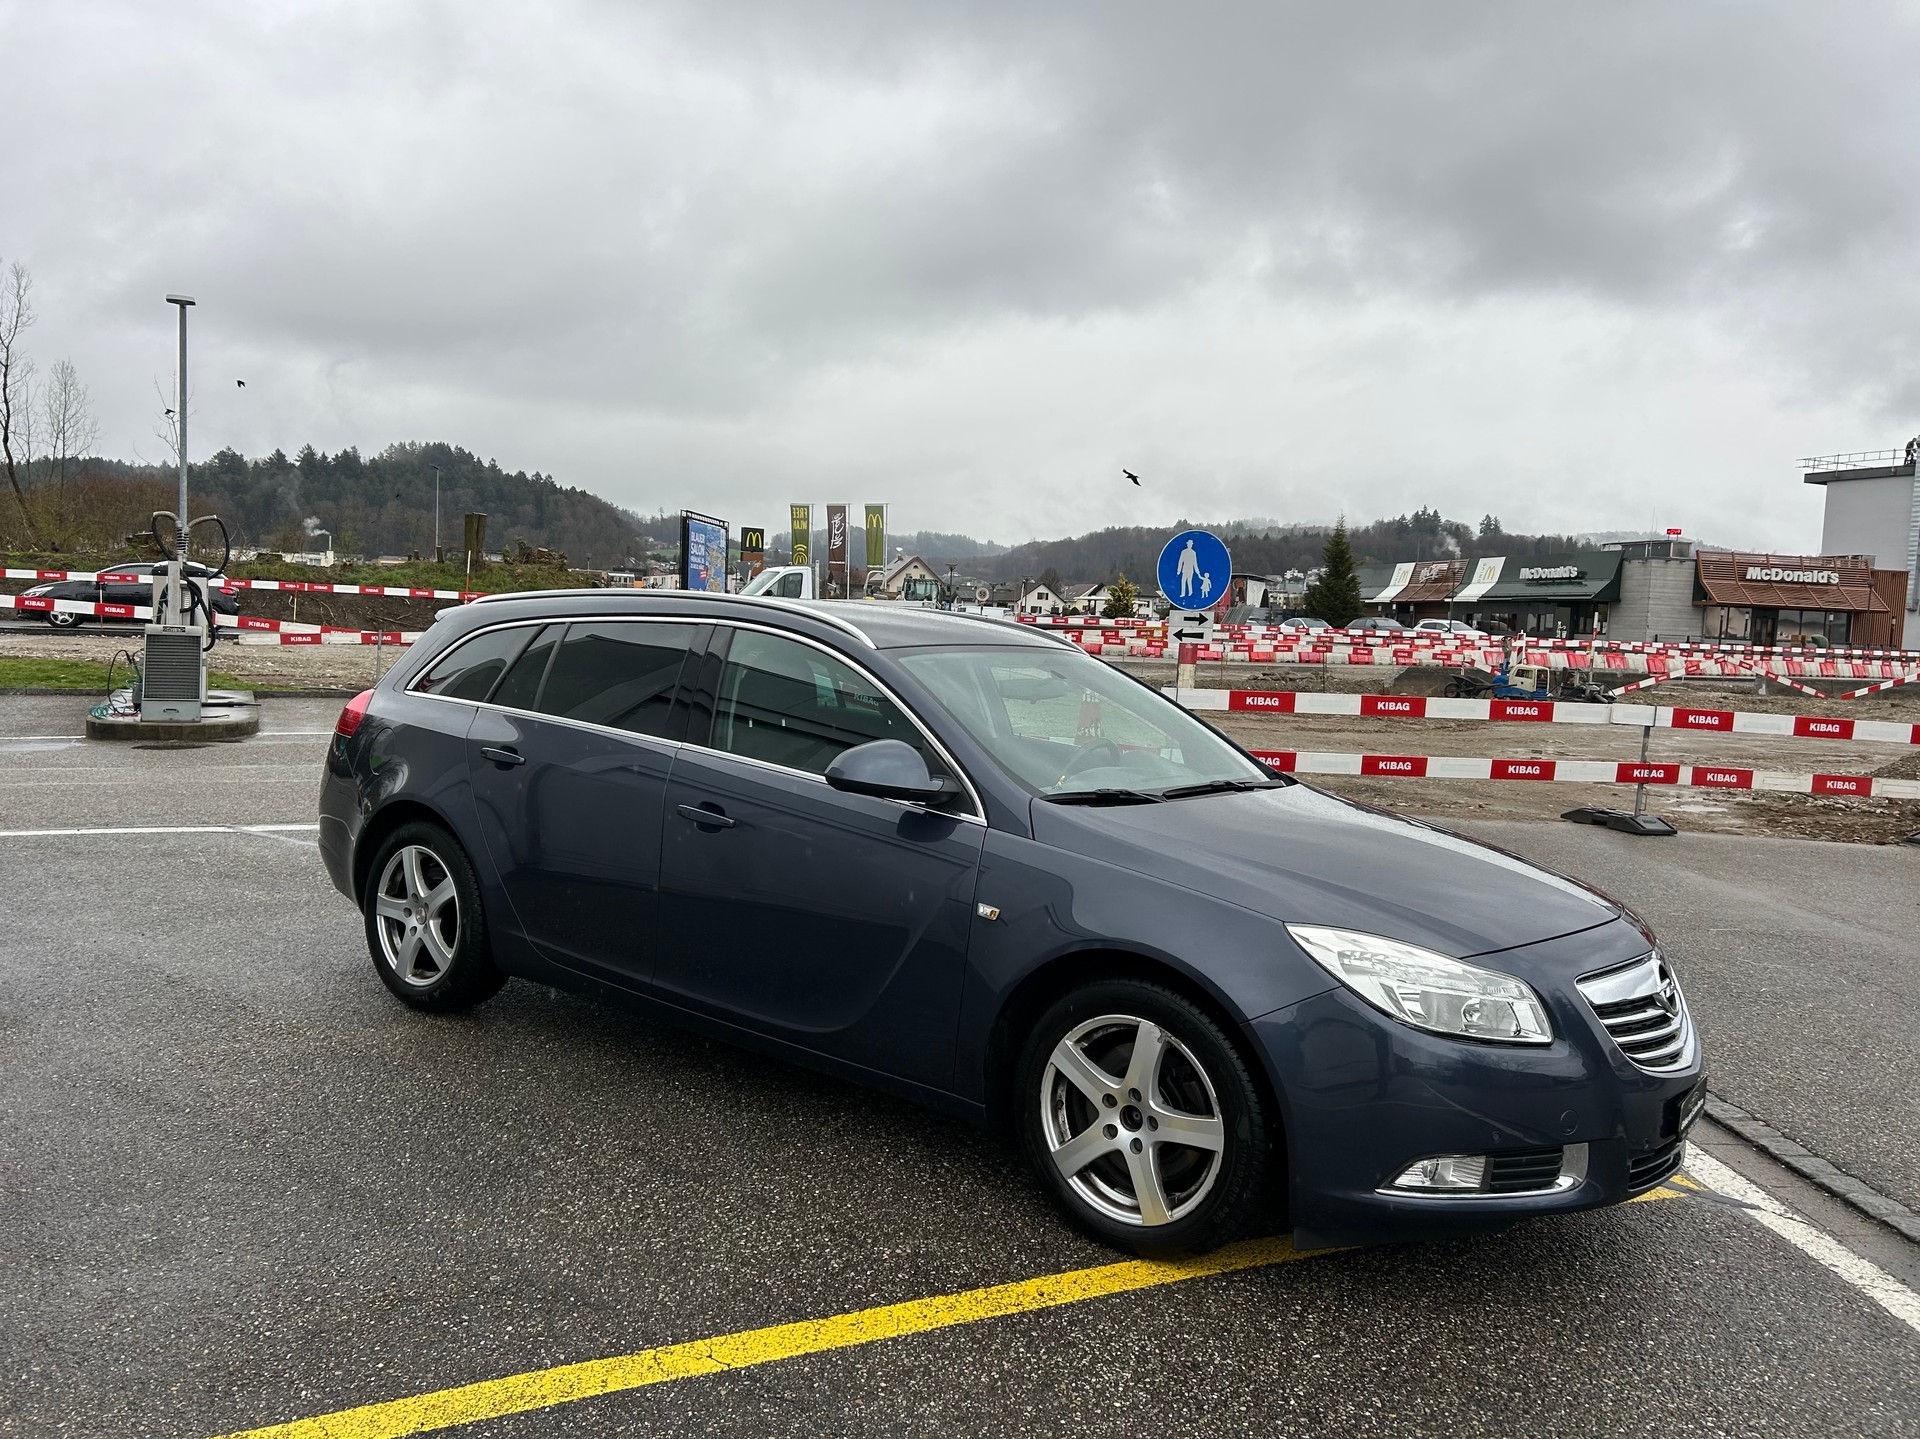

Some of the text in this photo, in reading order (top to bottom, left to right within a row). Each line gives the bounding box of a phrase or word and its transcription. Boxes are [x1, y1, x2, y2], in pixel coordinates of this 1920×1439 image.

[1519, 565, 1578, 580] McDonald's
[1746, 567, 1839, 584] McDonald's
[104, 606, 126, 614] KIBAG
[248, 621, 270, 629] KIBAG
[1246, 696, 1279, 706] KIBAG
[1377, 701, 1411, 711] KIBAG
[1506, 706, 1539, 716] KIBAG
[1688, 714, 1719, 725] KIBAG
[1809, 722, 1841, 733] KIBAG
[1257, 757, 1280, 766] BAG
[1378, 761, 1412, 771] KIBAG
[1507, 765, 1540, 775] KIBAG
[1633, 768, 1665, 778] KIBAG
[1706, 772, 1738, 783] KIBAG
[1826, 780, 1857, 790] KIBAG
